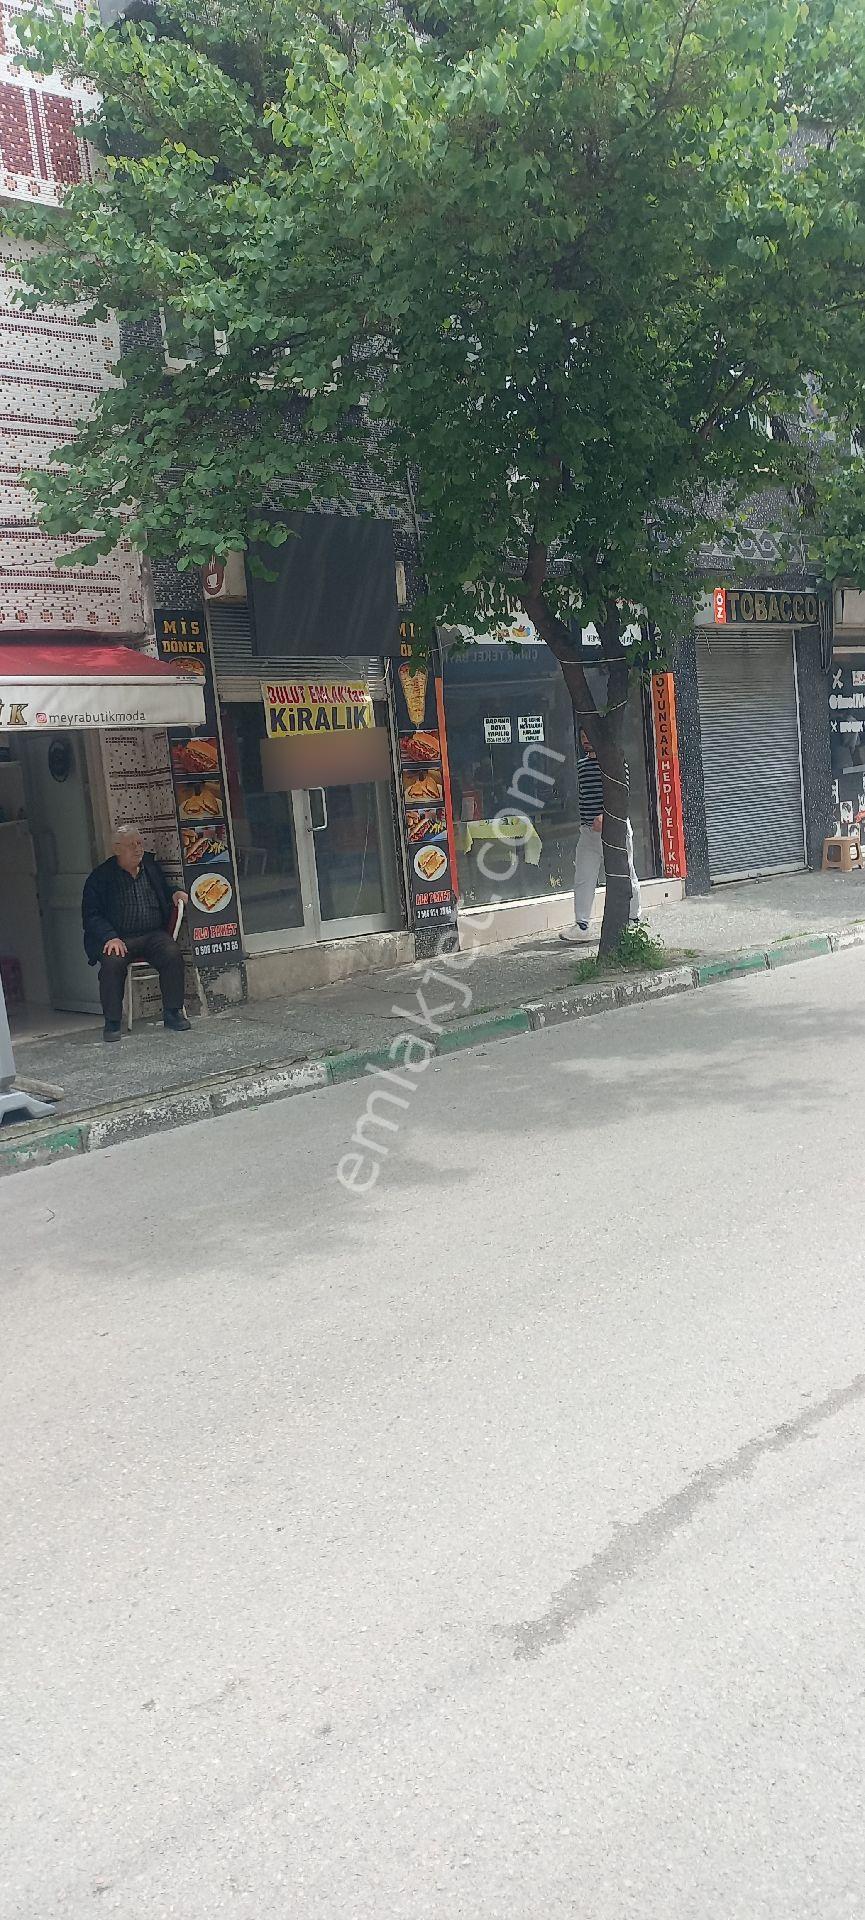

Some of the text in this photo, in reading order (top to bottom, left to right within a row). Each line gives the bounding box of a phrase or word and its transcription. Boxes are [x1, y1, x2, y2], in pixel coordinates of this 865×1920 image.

[728, 592, 818, 622] TOBACCO
[163, 616, 200, 635] MİS
[162, 637, 206, 654] DÖNER
[49, 710, 147, 725] meyrabutikmoda
[655, 677, 670, 757] OYUNCAK
[660, 760, 677, 861] HEDİYELİK
